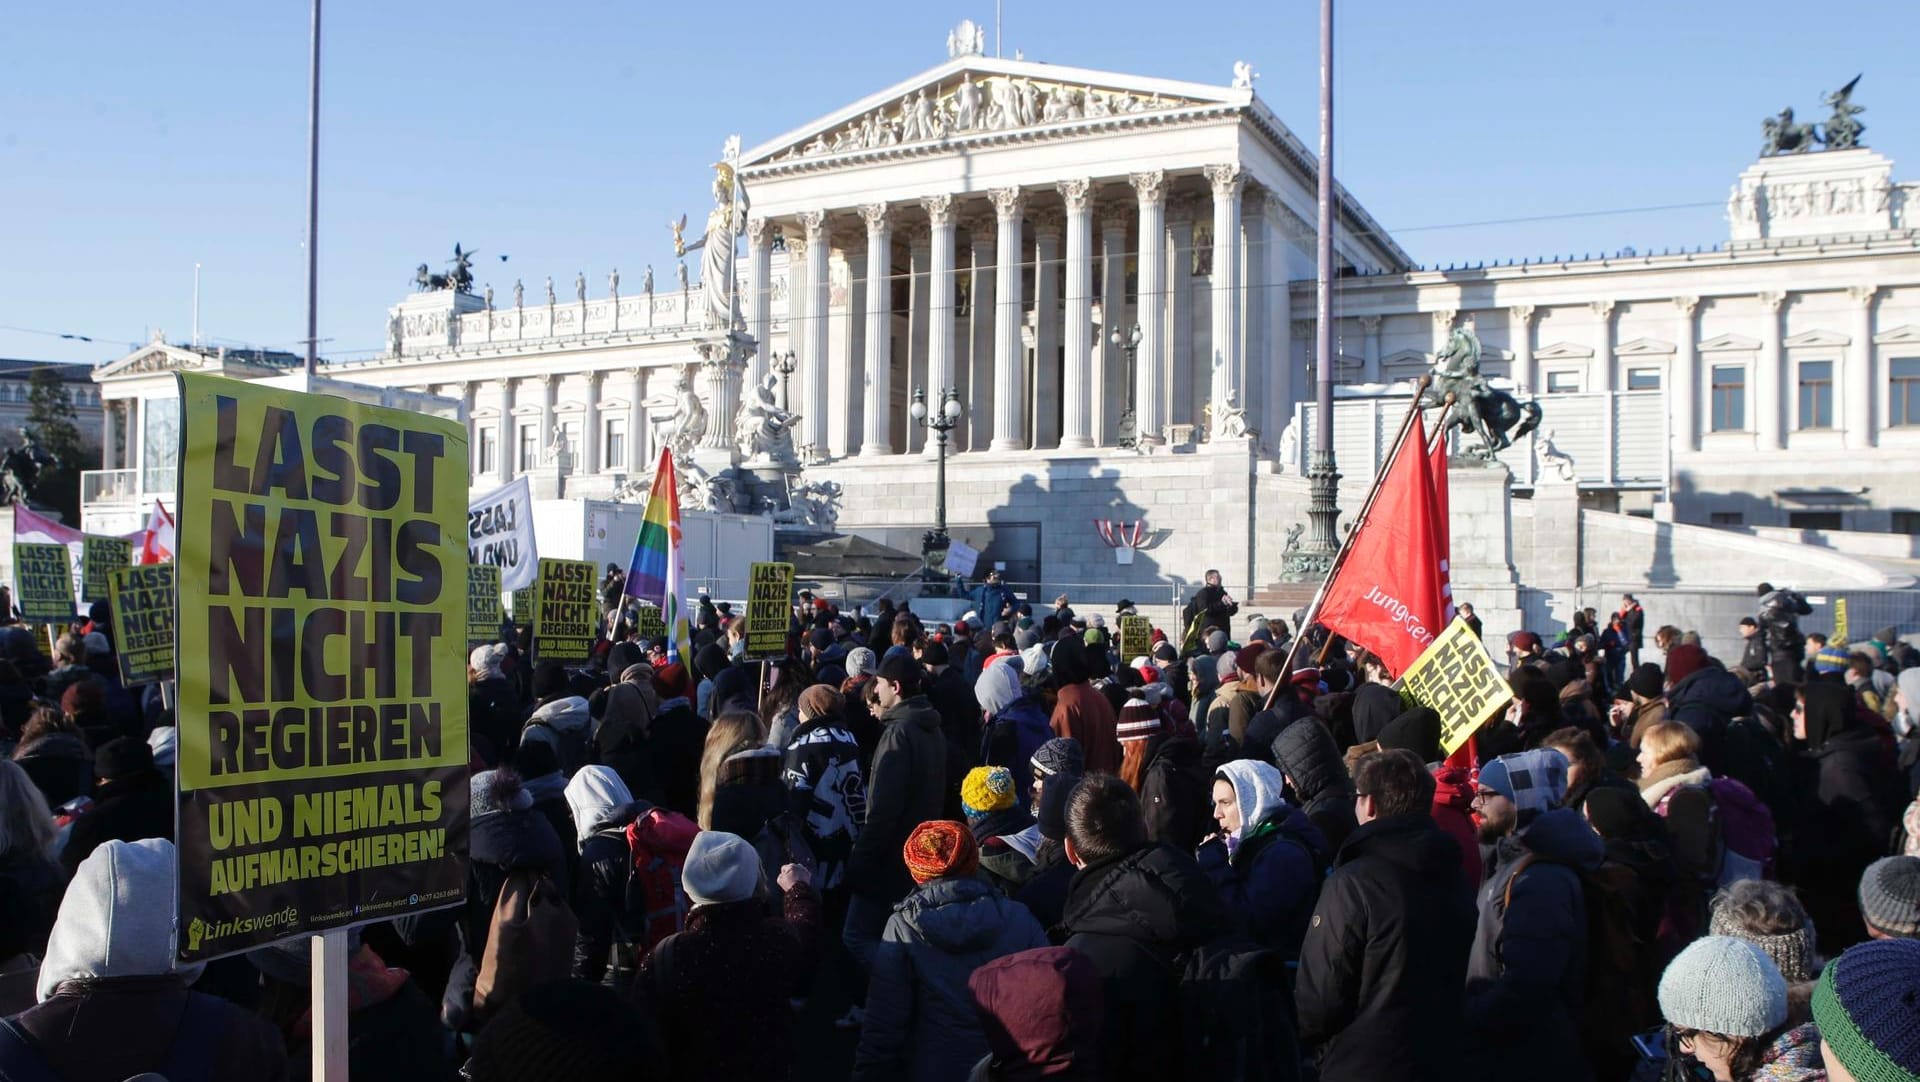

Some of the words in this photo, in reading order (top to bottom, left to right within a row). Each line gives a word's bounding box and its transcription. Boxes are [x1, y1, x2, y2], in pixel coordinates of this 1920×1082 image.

[213, 395, 444, 513] LASST
[19, 545, 63, 560] LASST
[88, 538, 128, 551] LASST
[208, 498, 442, 604] NAZIS
[20, 560, 65, 574] NAZIS
[89, 551, 128, 563] NAZIS
[22, 575, 66, 589] NICHT
[544, 562, 593, 582] LASST
[754, 565, 790, 582] LASST
[543, 582, 592, 602] NAZIS
[753, 583, 788, 600] NAZIS
[541, 602, 591, 622] NICHT
[751, 601, 787, 618] NICHT
[540, 622, 589, 636] REGIEREN
[751, 619, 786, 631] REGIEREN
[208, 604, 442, 704] NICHT
[539, 639, 556, 649] UND
[1451, 627, 1504, 700] LASST
[1435, 642, 1485, 718] NAZIS
[1419, 658, 1470, 732] NICHT
[209, 702, 442, 776] REGIEREN
[209, 797, 283, 850] UND
[294, 780, 442, 838] NIEMALS
[210, 828, 446, 896] AUFMARSCHIEREN!
[205, 906, 298, 940] Linkswende
